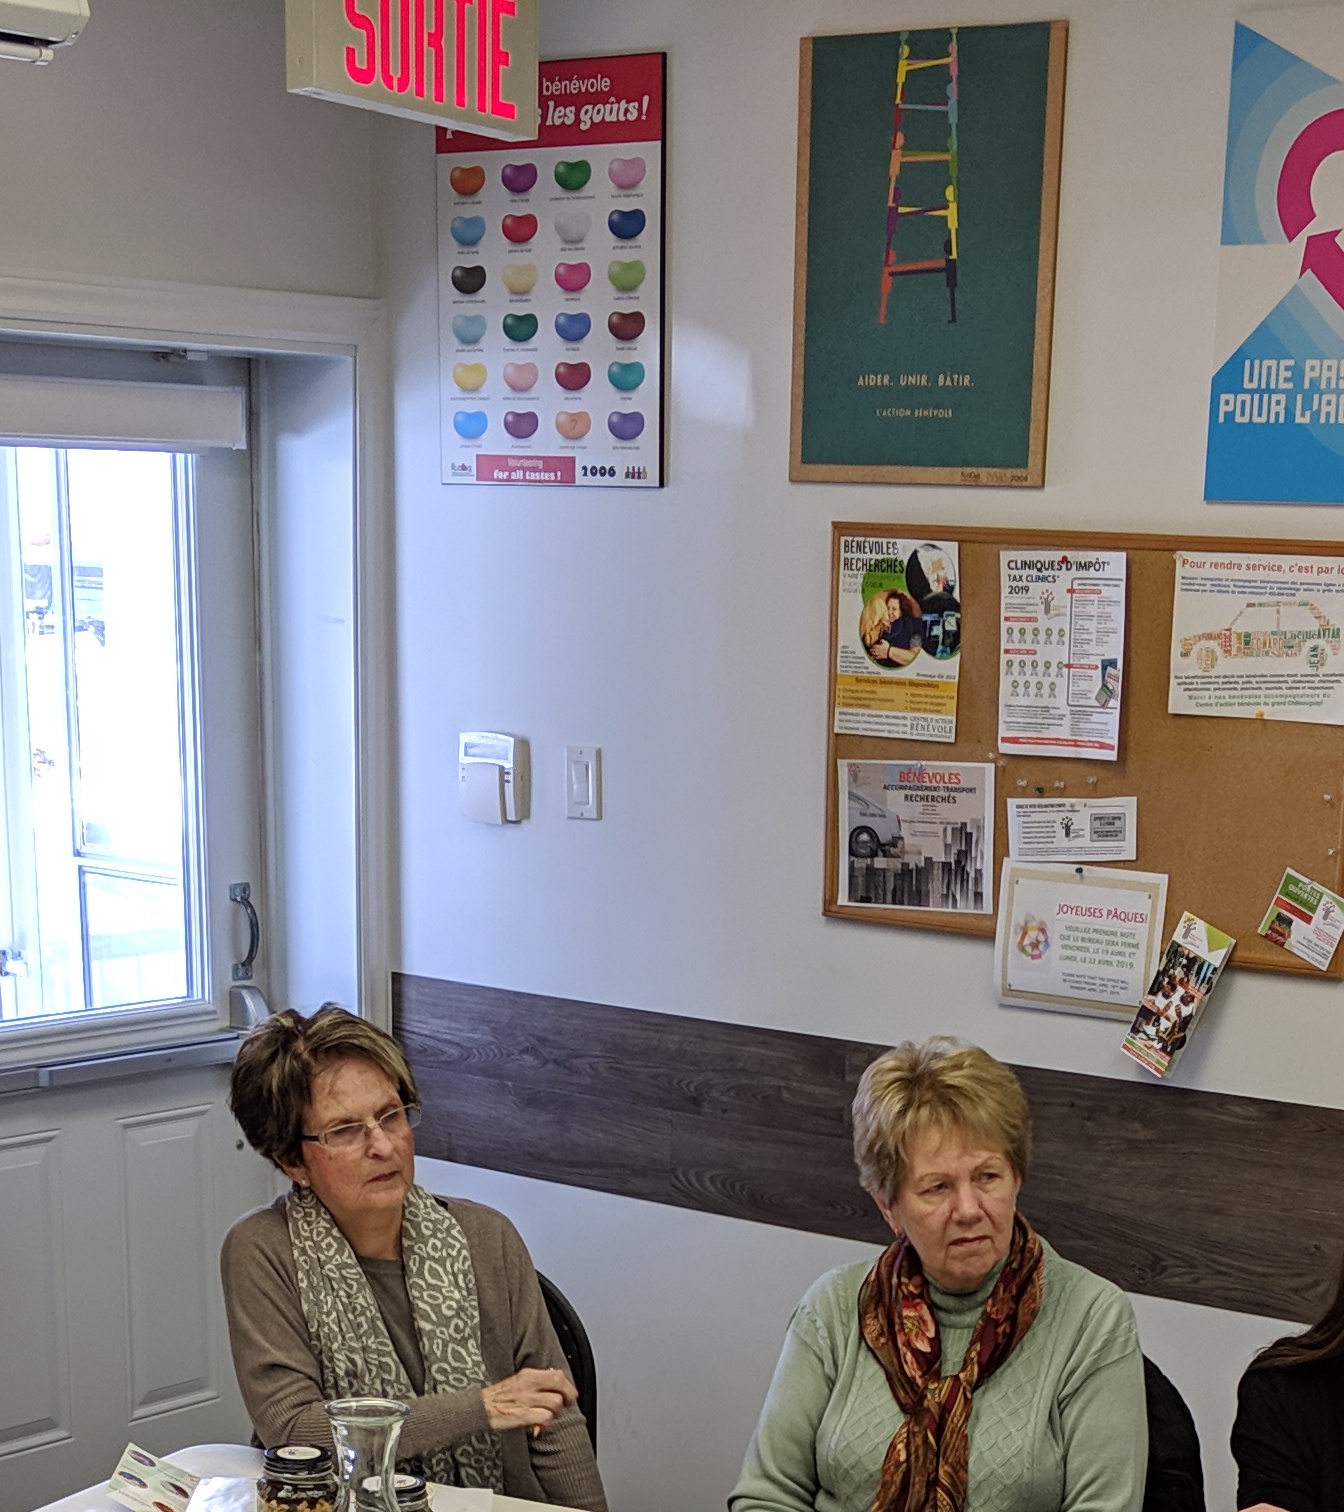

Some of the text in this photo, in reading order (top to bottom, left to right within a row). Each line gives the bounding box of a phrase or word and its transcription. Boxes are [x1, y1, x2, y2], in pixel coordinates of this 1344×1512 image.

[343, 0, 517, 120] SORTIE
[542, 74, 611, 96] bénévole
[545, 99, 577, 127] les
[857, 371, 975, 387] AIDER. UNIR. BÂTIR.
[1242, 358, 1295, 390] UNE
[1218, 393, 1288, 425] POUR
[493, 469, 524, 480] for all
[581, 465, 617, 478] 2006
[843, 537, 899, 556] BÉNÉVOLES
[843, 556, 905, 575] RECHERCHÉS
[1006, 559, 1064, 572] CLINIQUES
[1181, 557, 1207, 569] Pour
[1209, 559, 1243, 571] rendre
[1245, 561, 1286, 574] service,
[1288, 562, 1314, 575] c'est
[1316, 566, 1335, 576] par
[1007, 573, 1024, 583] TAX
[1007, 585, 1030, 596] 2019
[898, 768, 962, 785] BÉNÉVOLES
[903, 793, 958, 805] RECHERCHÉS
[1056, 903, 1149, 924] JOYEUSES PÂQUES!
